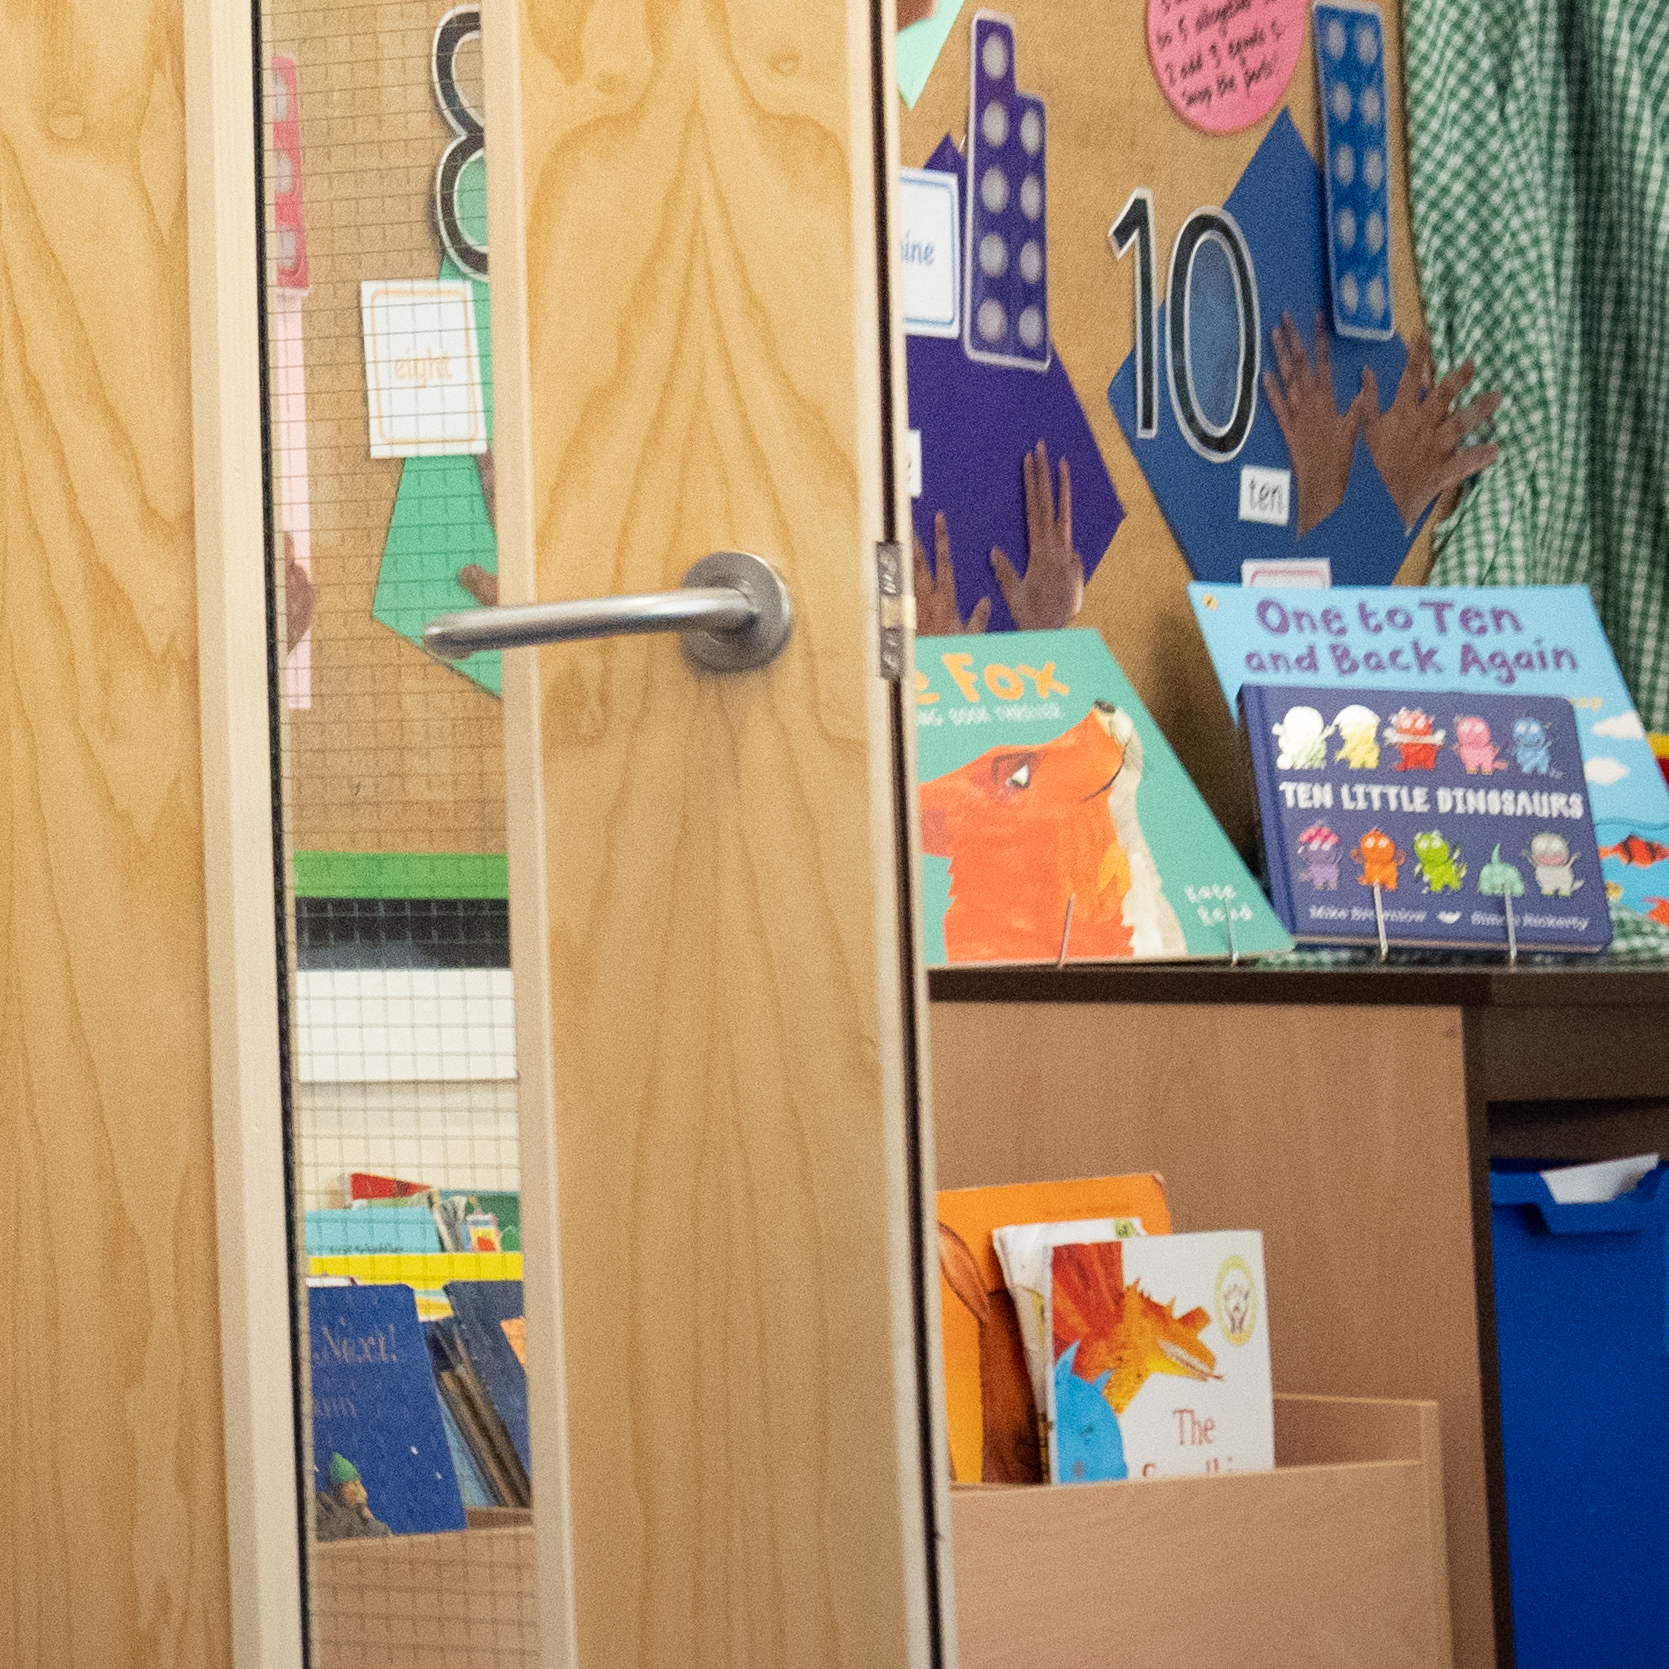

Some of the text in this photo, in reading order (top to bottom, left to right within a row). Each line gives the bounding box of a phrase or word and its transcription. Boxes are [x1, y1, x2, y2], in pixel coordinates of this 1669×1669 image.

[1109, 190, 1259, 462] 10
[393, 348, 452, 389] eight
[1248, 475, 1285, 517] ten
[1256, 599, 1523, 637] One to Ten
[942, 653, 1070, 703] Fox
[1245, 636, 1578, 684] and Back Again
[1279, 781, 1585, 820] TEN LITTLE DINOSAURS
[1172, 1407, 1217, 1447] The
